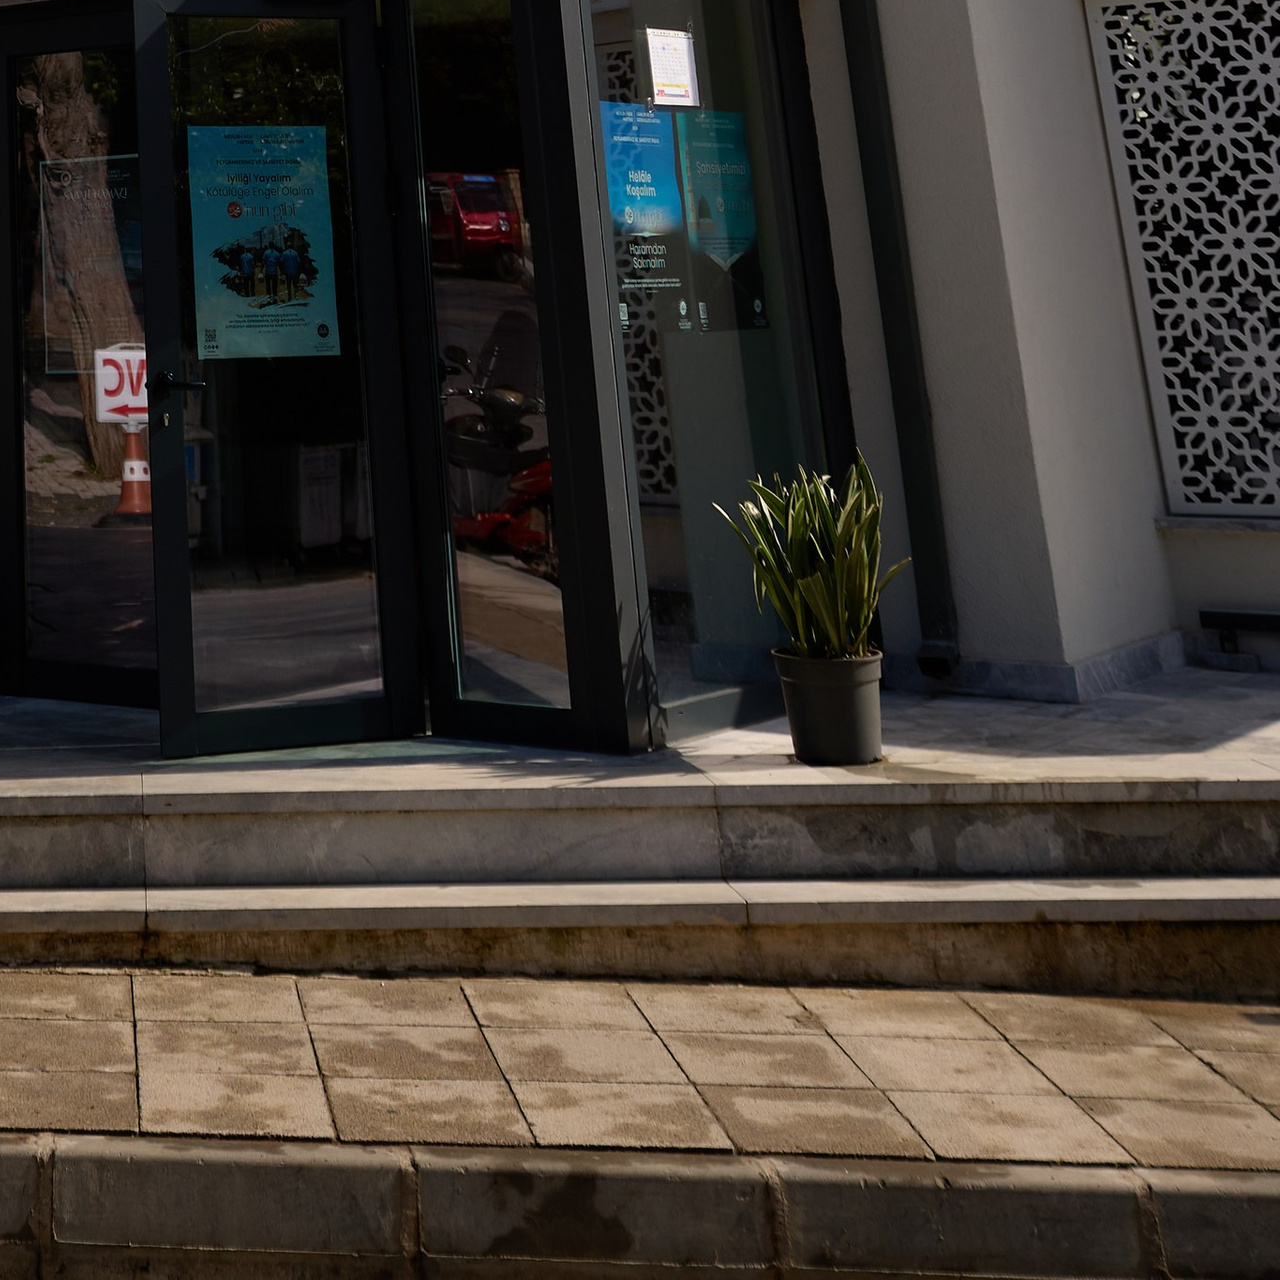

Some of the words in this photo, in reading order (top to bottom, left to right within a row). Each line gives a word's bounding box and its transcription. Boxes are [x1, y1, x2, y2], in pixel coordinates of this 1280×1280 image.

[227, 172, 251, 185] İyiliği
[253, 173, 291, 184] Yayalım
[628, 170, 652, 183] Helâle
[252, 187, 279, 199] Engel
[281, 186, 314, 197] Olalım
[626, 184, 656, 200] Koşalım
[273, 202, 296, 222] gibi
[629, 243, 667, 255] Haramdan
